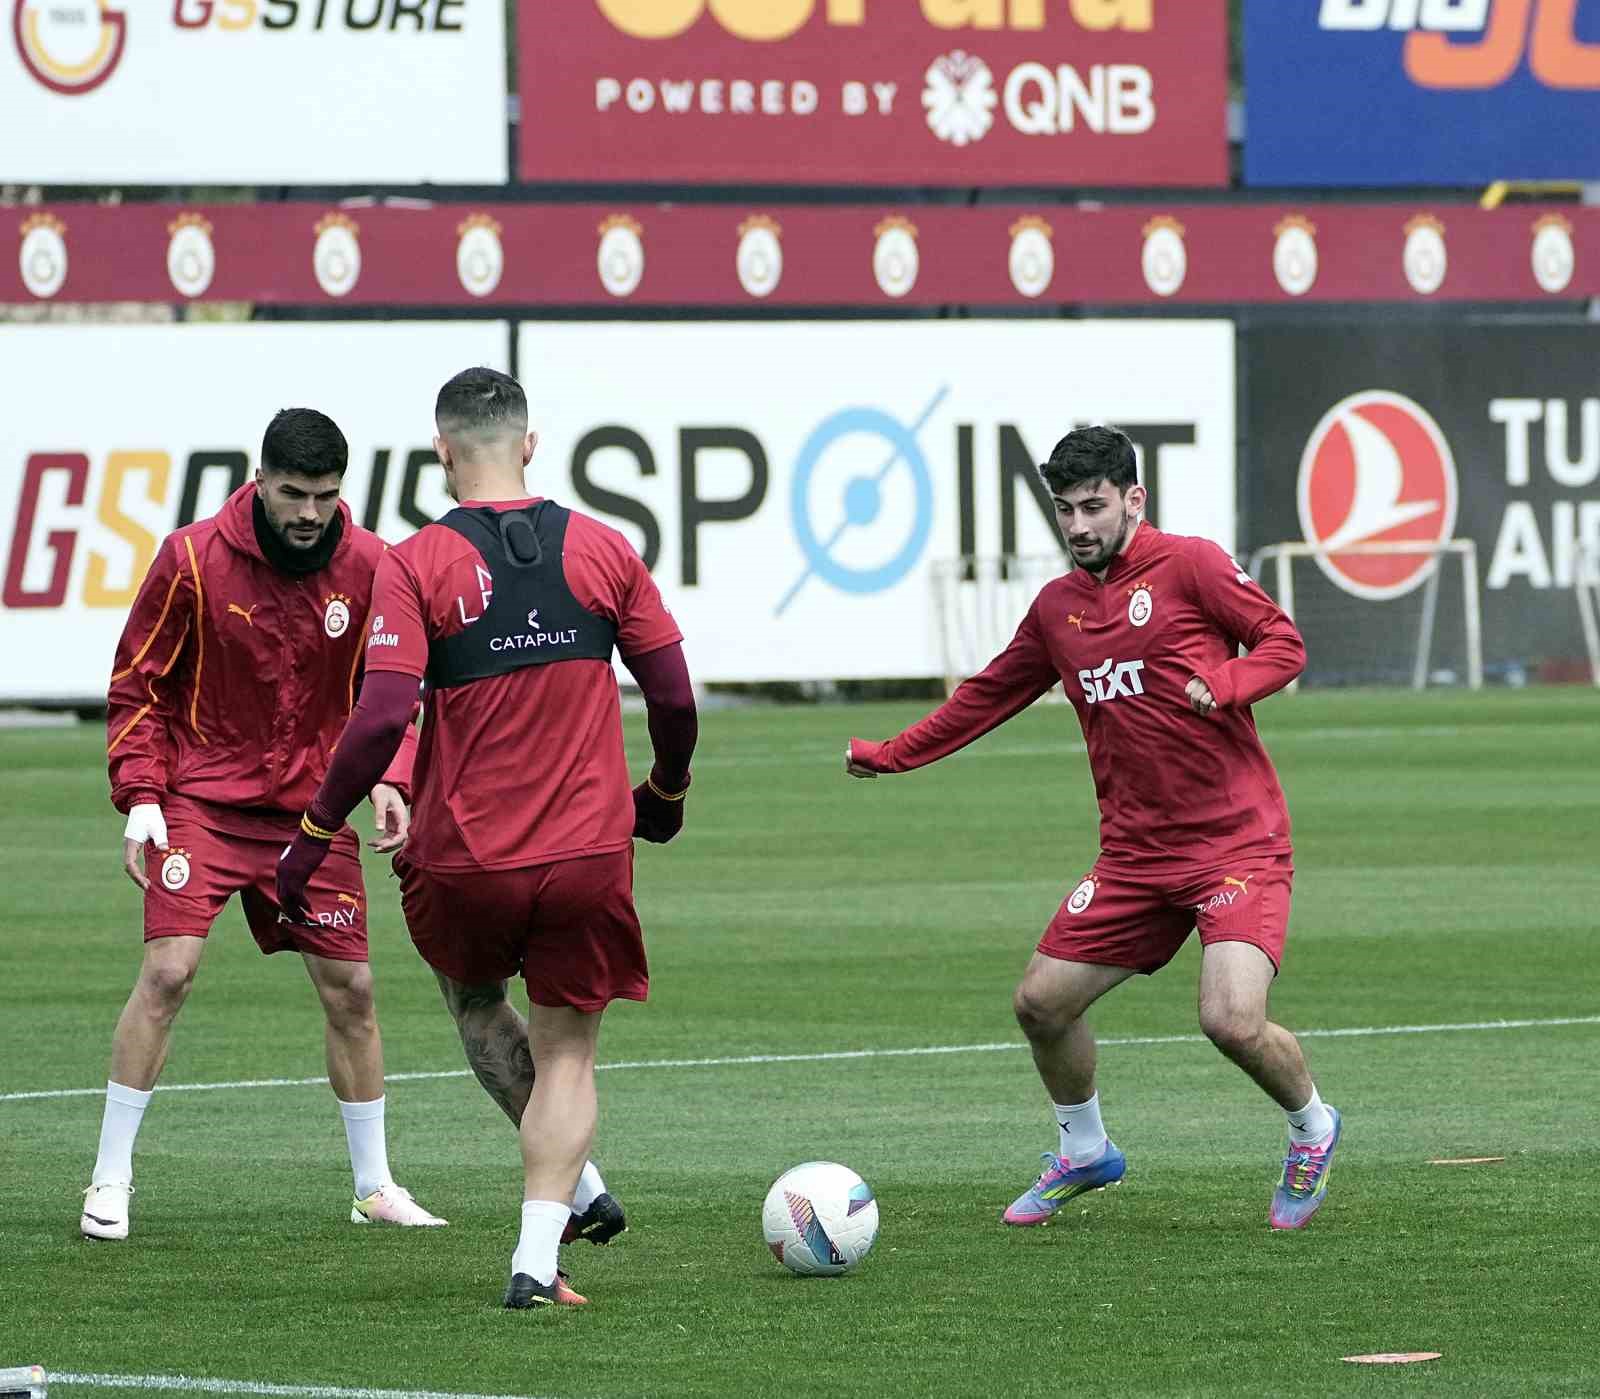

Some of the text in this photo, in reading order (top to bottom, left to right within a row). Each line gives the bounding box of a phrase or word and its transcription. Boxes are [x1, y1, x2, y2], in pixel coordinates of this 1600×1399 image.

[596, 78, 897, 115] POWERED BY
[1004, 63, 1155, 135] QNB
[490, 630, 577, 651] CATAPULT
